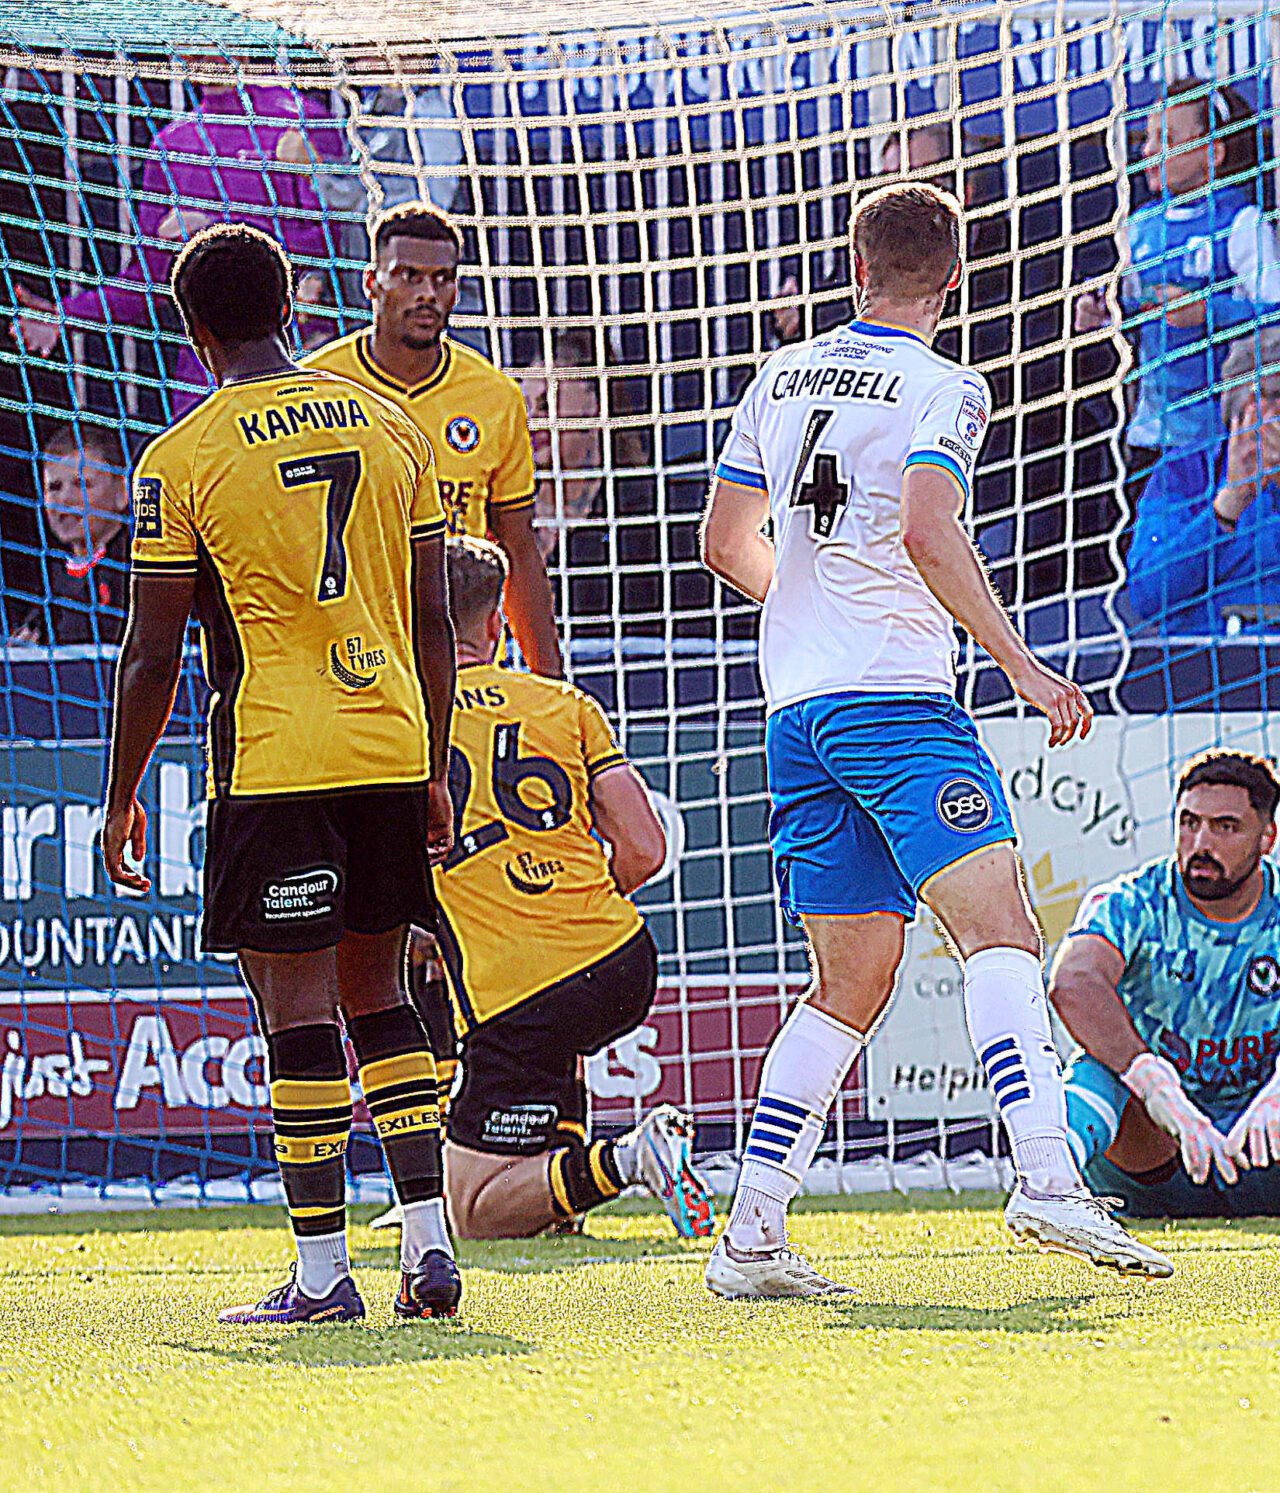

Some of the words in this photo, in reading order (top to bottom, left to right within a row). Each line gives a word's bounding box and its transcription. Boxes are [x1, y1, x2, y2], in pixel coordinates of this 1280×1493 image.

[772, 367, 901, 403] CAMPBELL
[238, 399, 370, 445] KAMWA
[789, 409, 848, 538] 4
[277, 450, 362, 602] 7
[346, 636, 362, 654] 57
[348, 649, 386, 671] TYRES
[942, 793, 986, 820] DSG
[523, 860, 565, 880] TYRES
[263, 895, 314, 909] Talent.
[268, 879, 329, 898] Candour
[0, 915, 238, 967] UNTANT
[1196, 1028, 1279, 1066] PURE
[377, 1111, 440, 1135] EXILES
